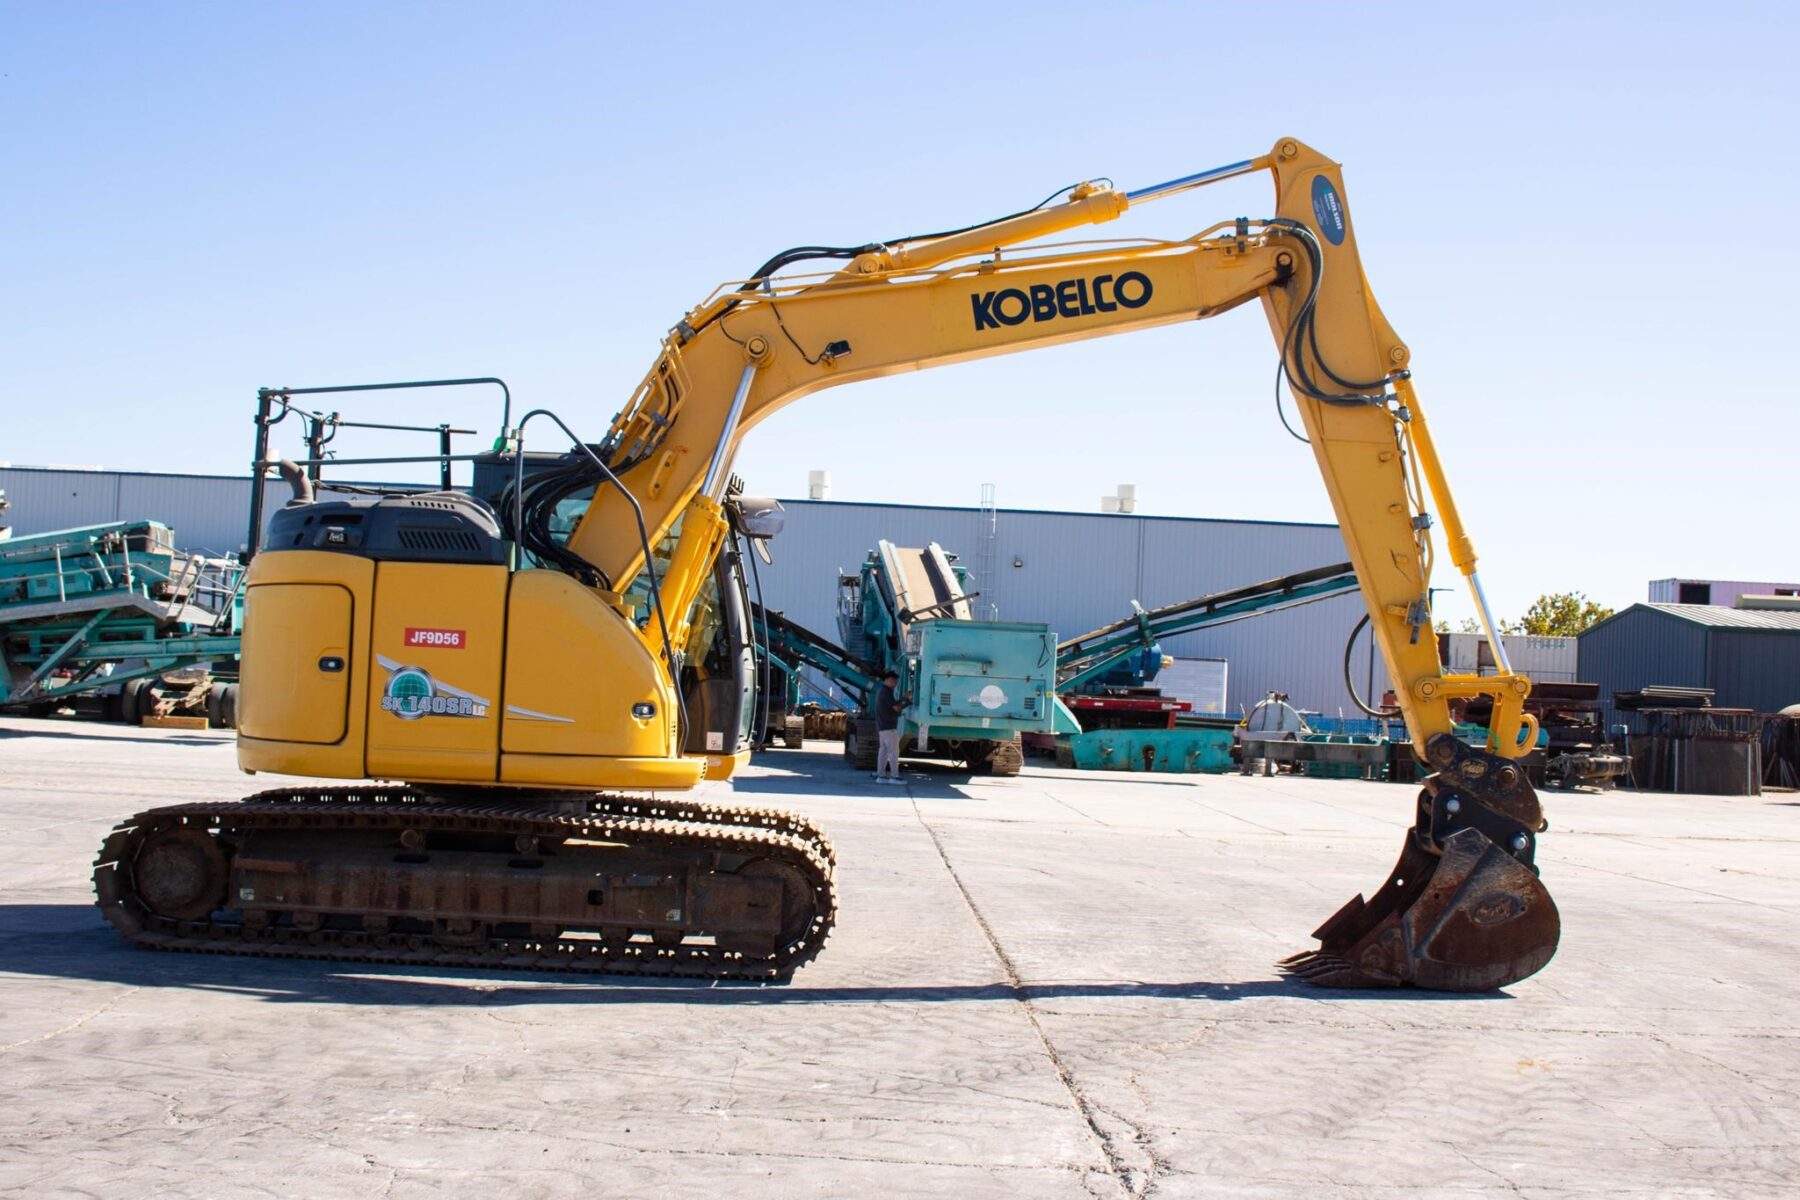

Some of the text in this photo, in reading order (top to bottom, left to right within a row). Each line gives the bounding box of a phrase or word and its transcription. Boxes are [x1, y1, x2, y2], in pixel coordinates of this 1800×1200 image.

[971, 271, 1153, 331] KOBELCO
[411, 631, 460, 646] JF9D56
[382, 696, 404, 711] SK
